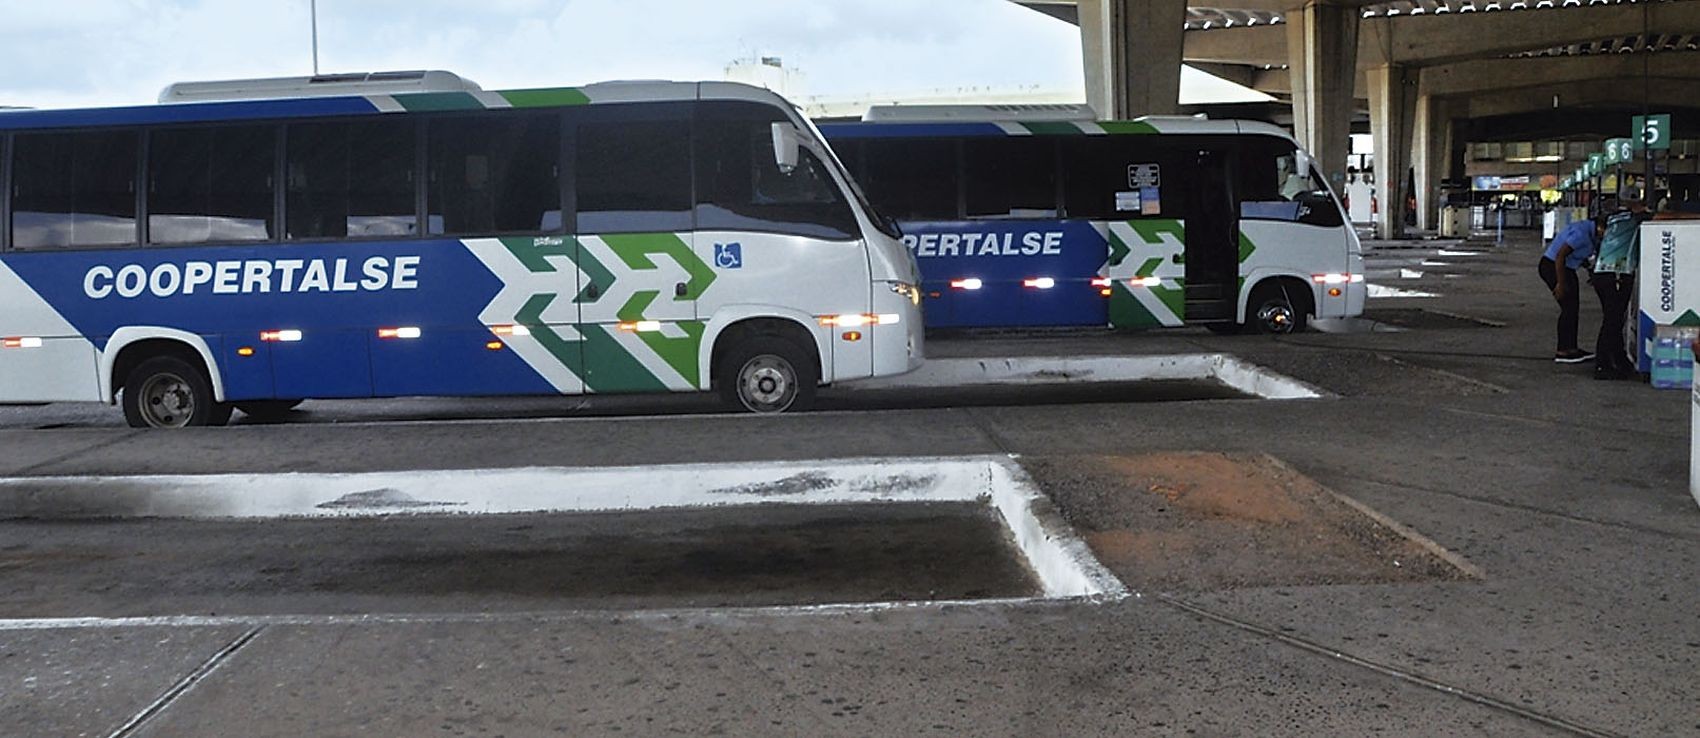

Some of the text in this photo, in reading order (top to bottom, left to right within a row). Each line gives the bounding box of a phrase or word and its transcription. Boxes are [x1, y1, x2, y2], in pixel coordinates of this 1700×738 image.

[1641, 120, 1659, 144] 5
[1608, 143, 1617, 160] 6
[1622, 143, 1631, 160] 6
[1592, 156, 1599, 169] 7
[83, 255, 421, 299] COOPERTALSE
[1661, 231, 1672, 312] COOPERTALSE
